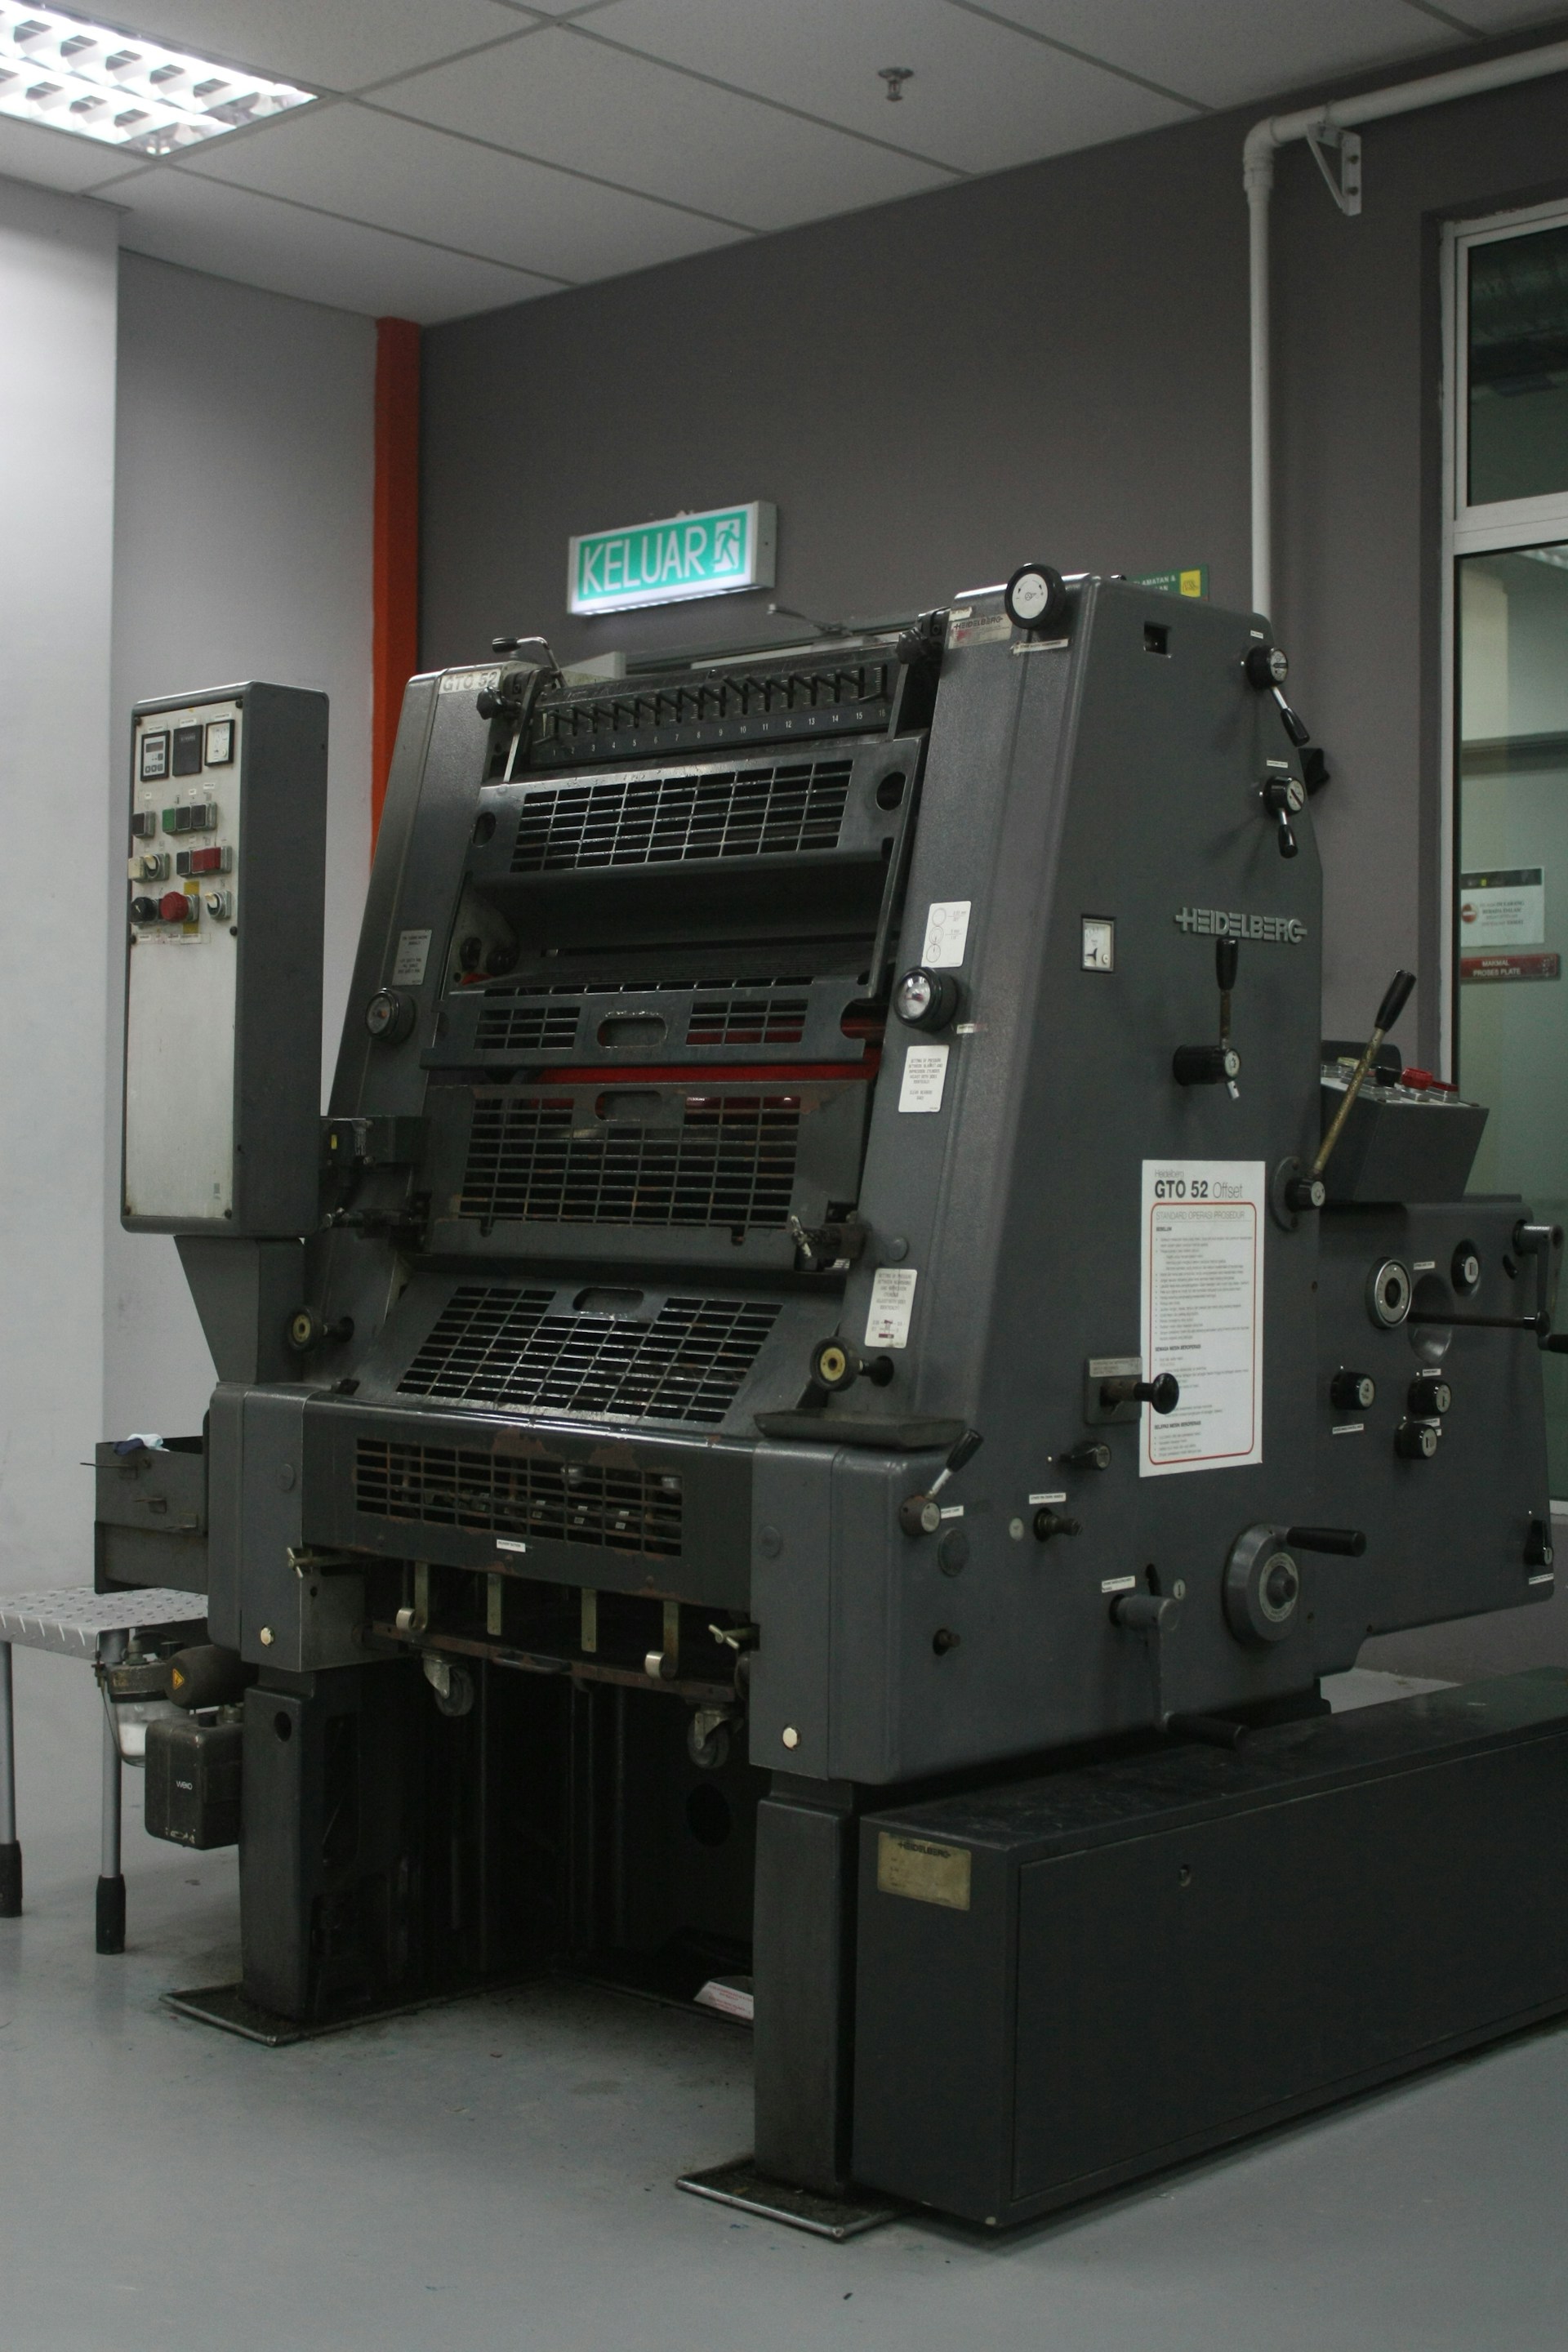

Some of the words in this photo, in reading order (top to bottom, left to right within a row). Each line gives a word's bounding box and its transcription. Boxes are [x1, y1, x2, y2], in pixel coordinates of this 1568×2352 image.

[583, 526, 708, 595] KELUAR
[954, 616, 1004, 630] HEIDELBERG
[443, 673, 474, 692] GTO
[479, 670, 498, 688] 52
[591, 744, 595, 752] 3
[632, 738, 636, 746] 5
[675, 733, 679, 742] 7
[697, 731, 701, 739] 8
[740, 725, 746, 733] 10
[762, 723, 768, 731] 11
[786, 720, 792, 728] 12
[808, 717, 815, 725] 13
[832, 715, 839, 723] 14
[856, 711, 863, 719] 15
[1175, 907, 1307, 943] HEIDELBERG
[1155, 1179, 1186, 1198] GTO
[1191, 1180, 1208, 1198] 52
[1213, 1182, 1243, 1198] Offset
[1156, 1211, 1187, 1220] STANDARD
[1188, 1211, 1213, 1219] OPERASI
[1214, 1210, 1245, 1219] PROSEDUR
[898, 1840, 951, 1859] HEIDELBERG
